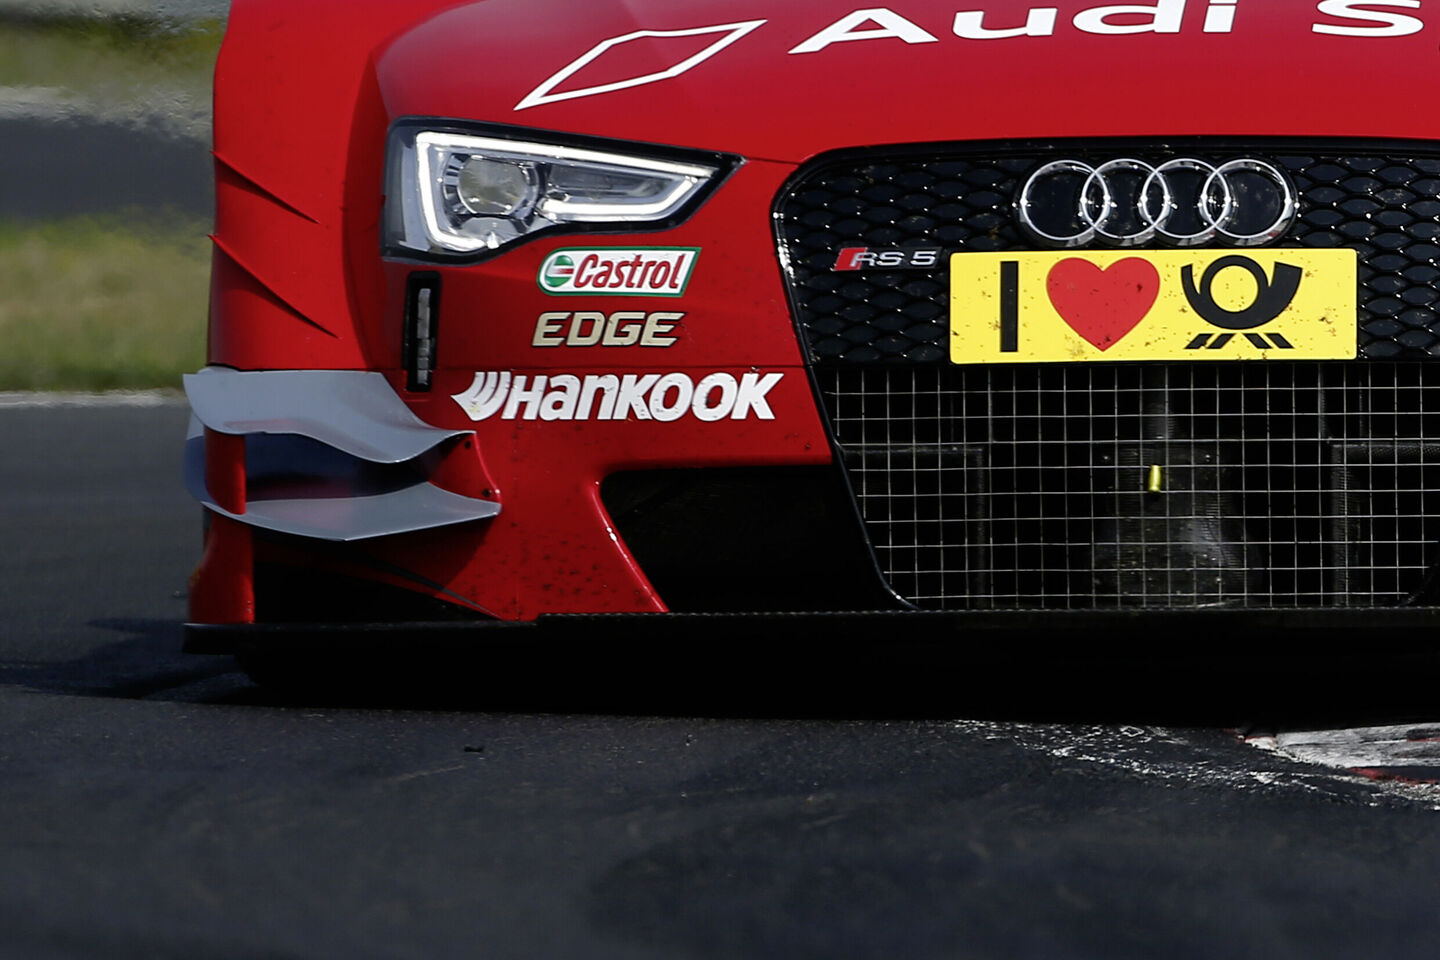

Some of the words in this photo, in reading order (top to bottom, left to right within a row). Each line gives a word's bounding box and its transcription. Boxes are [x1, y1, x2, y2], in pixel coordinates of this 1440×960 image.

[573, 253, 686, 289] Castrol
[850, 251, 905, 268] RS
[910, 250, 937, 266] 5
[1000, 260, 1019, 353] I
[531, 311, 686, 347] EDGE
